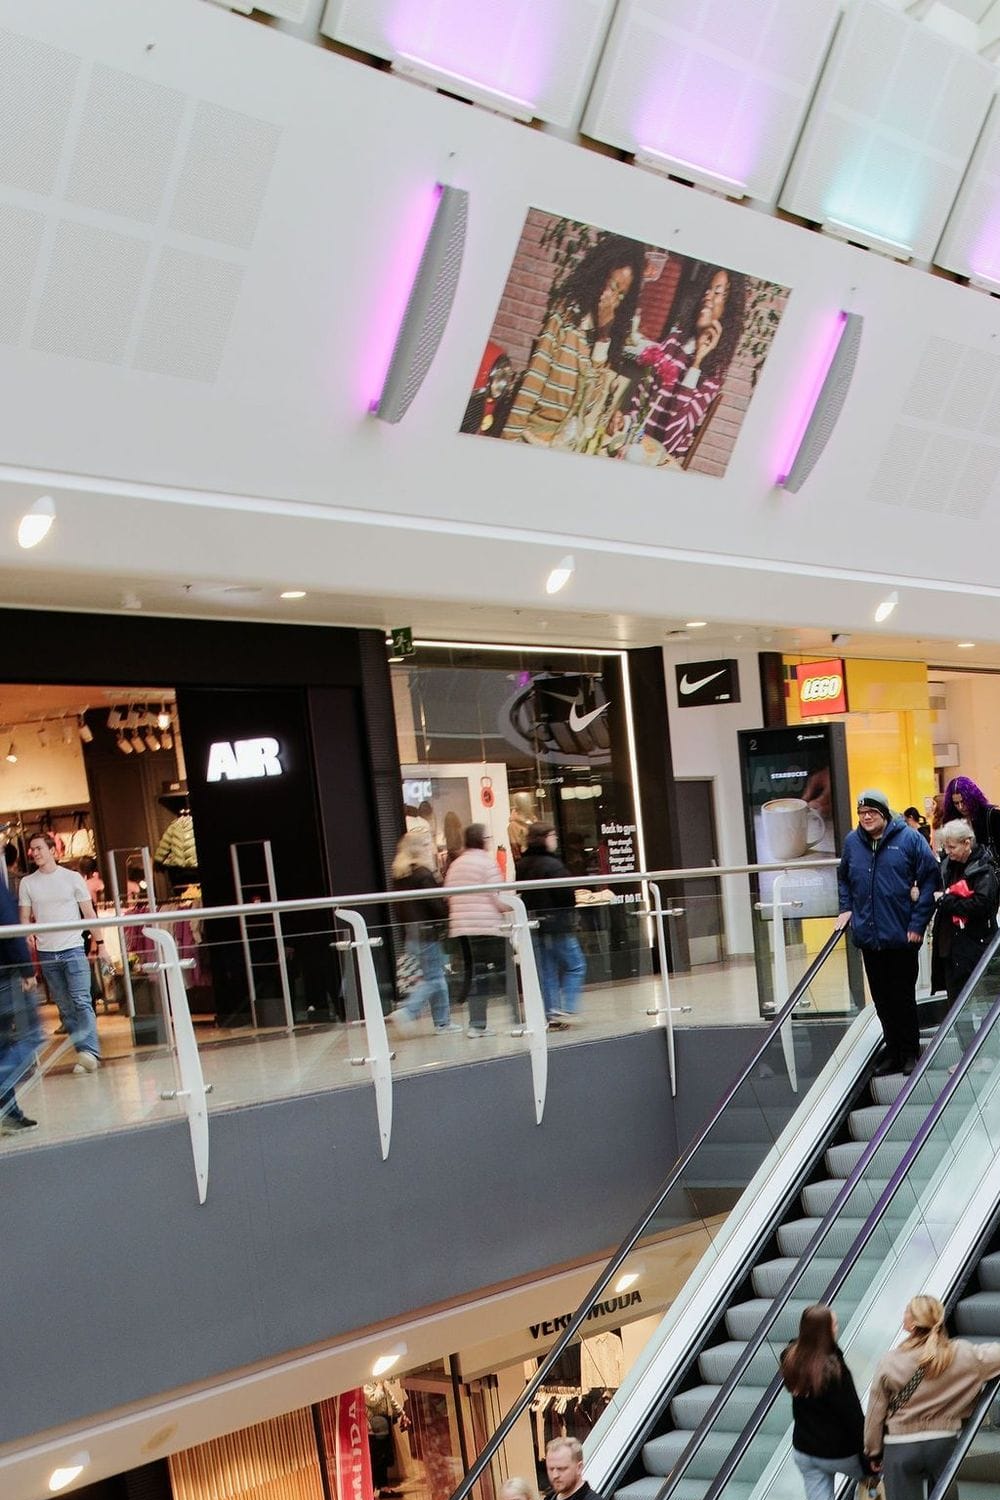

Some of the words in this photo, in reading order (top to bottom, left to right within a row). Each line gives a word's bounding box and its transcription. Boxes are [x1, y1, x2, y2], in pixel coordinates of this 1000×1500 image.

[803, 677, 841, 700] LEGO
[749, 739, 758, 751] 2
[206, 737, 283, 783] AIR
[770, 770, 809, 780] STARBUCKS
[529, 1312, 576, 1339] VER
